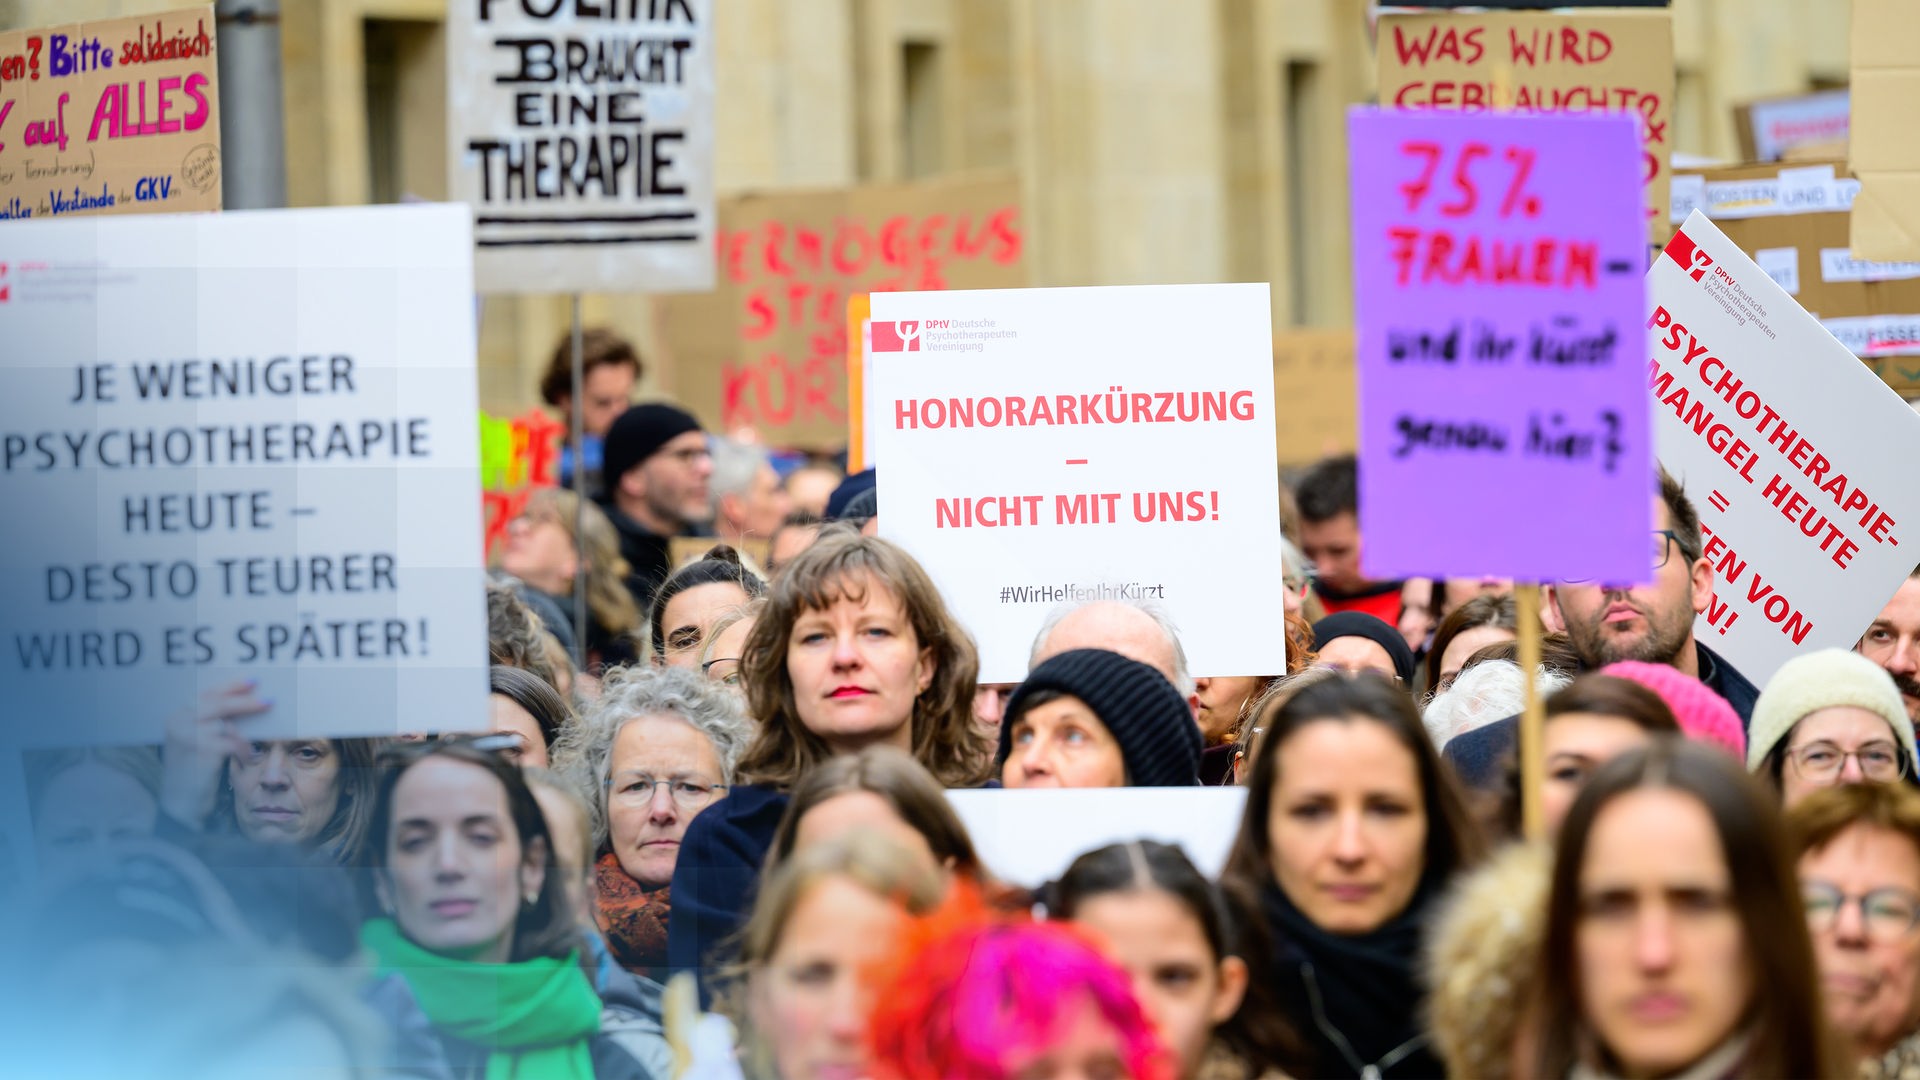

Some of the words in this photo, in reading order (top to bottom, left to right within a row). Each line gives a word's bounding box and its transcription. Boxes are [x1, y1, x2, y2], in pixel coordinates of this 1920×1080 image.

[0, 36, 42, 80] en?
[50, 34, 113, 77] Bitte
[494, 39, 691, 84] BRAUCHT
[1393, 25, 1484, 67] WAS
[1509, 26, 1613, 67] WIRD
[24, 92, 69, 151] auf
[87, 72, 209, 142] ALLES
[516, 92, 643, 126] EINE
[469, 131, 685, 201] THERAPIE
[1401, 141, 1540, 218] 75%
[1703, 282, 1746, 327] Vereinigung
[1709, 274, 1776, 340] Psychotherapeuten
[1714, 266, 1736, 286] DPtV
[1733, 284, 1767, 318] Deutsche
[925, 319, 950, 329] DPtV
[951, 317, 996, 328] Deutsche
[926, 329, 1017, 342] Psychotherapeuten
[1389, 322, 1459, 362] und
[1474, 322, 1519, 360] ihr
[926, 342, 984, 353] Vereinigung
[71, 363, 117, 404] JE
[133, 354, 357, 400] WENIGER
[895, 385, 1255, 430] HONORARKÜRZUNG
[1645, 305, 1899, 547] PSYCHOTHERAPIE-
[4, 418, 431, 473] PSYCHOTHERAPIE
[1396, 414, 1507, 458] genau
[1526, 410, 1623, 473] hier?
[1648, 358, 1760, 485] MANGEL
[1761, 473, 1860, 570] HEUTE
[123, 491, 272, 534] HEUTE
[935, 495, 1043, 529] NICHT
[1055, 493, 1121, 525] MIT
[1133, 491, 1219, 523] UNS!
[47, 561, 198, 604] DESTO
[217, 553, 398, 597] TEURER
[1000, 582, 1164, 604] #WirHelfenIhrKürzt
[1747, 573, 1814, 646] VON
[16, 630, 143, 670] WIRD
[164, 626, 216, 666] ES
[237, 612, 429, 664] SPÄTER!
